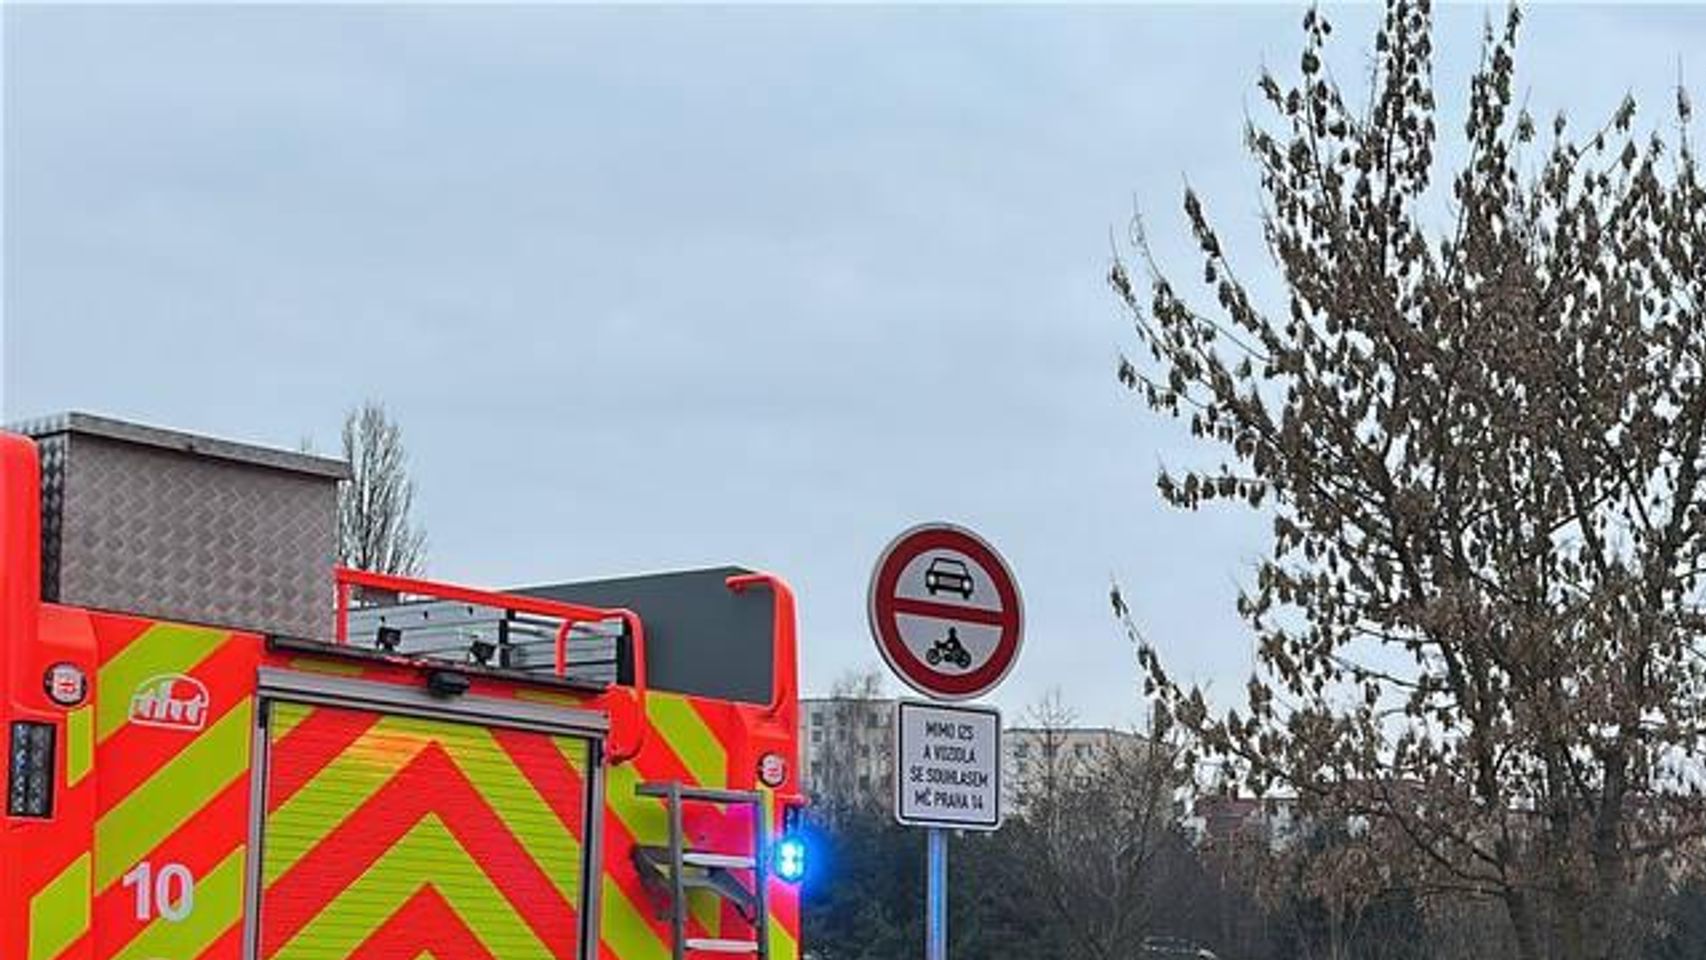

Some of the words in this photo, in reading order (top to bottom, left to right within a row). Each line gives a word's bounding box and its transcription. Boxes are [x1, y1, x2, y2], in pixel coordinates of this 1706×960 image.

[925, 720, 956, 739] MIMO
[958, 724, 975, 740] IZS
[923, 744, 932, 760] A
[934, 746, 977, 764] VOZIDLA
[910, 764, 924, 782] SE
[926, 768, 989, 788] SOUHLASEM
[914, 787, 932, 807] MČ
[935, 791, 970, 809] PRAHA
[971, 794, 984, 809] 14
[122, 861, 195, 922] 10
